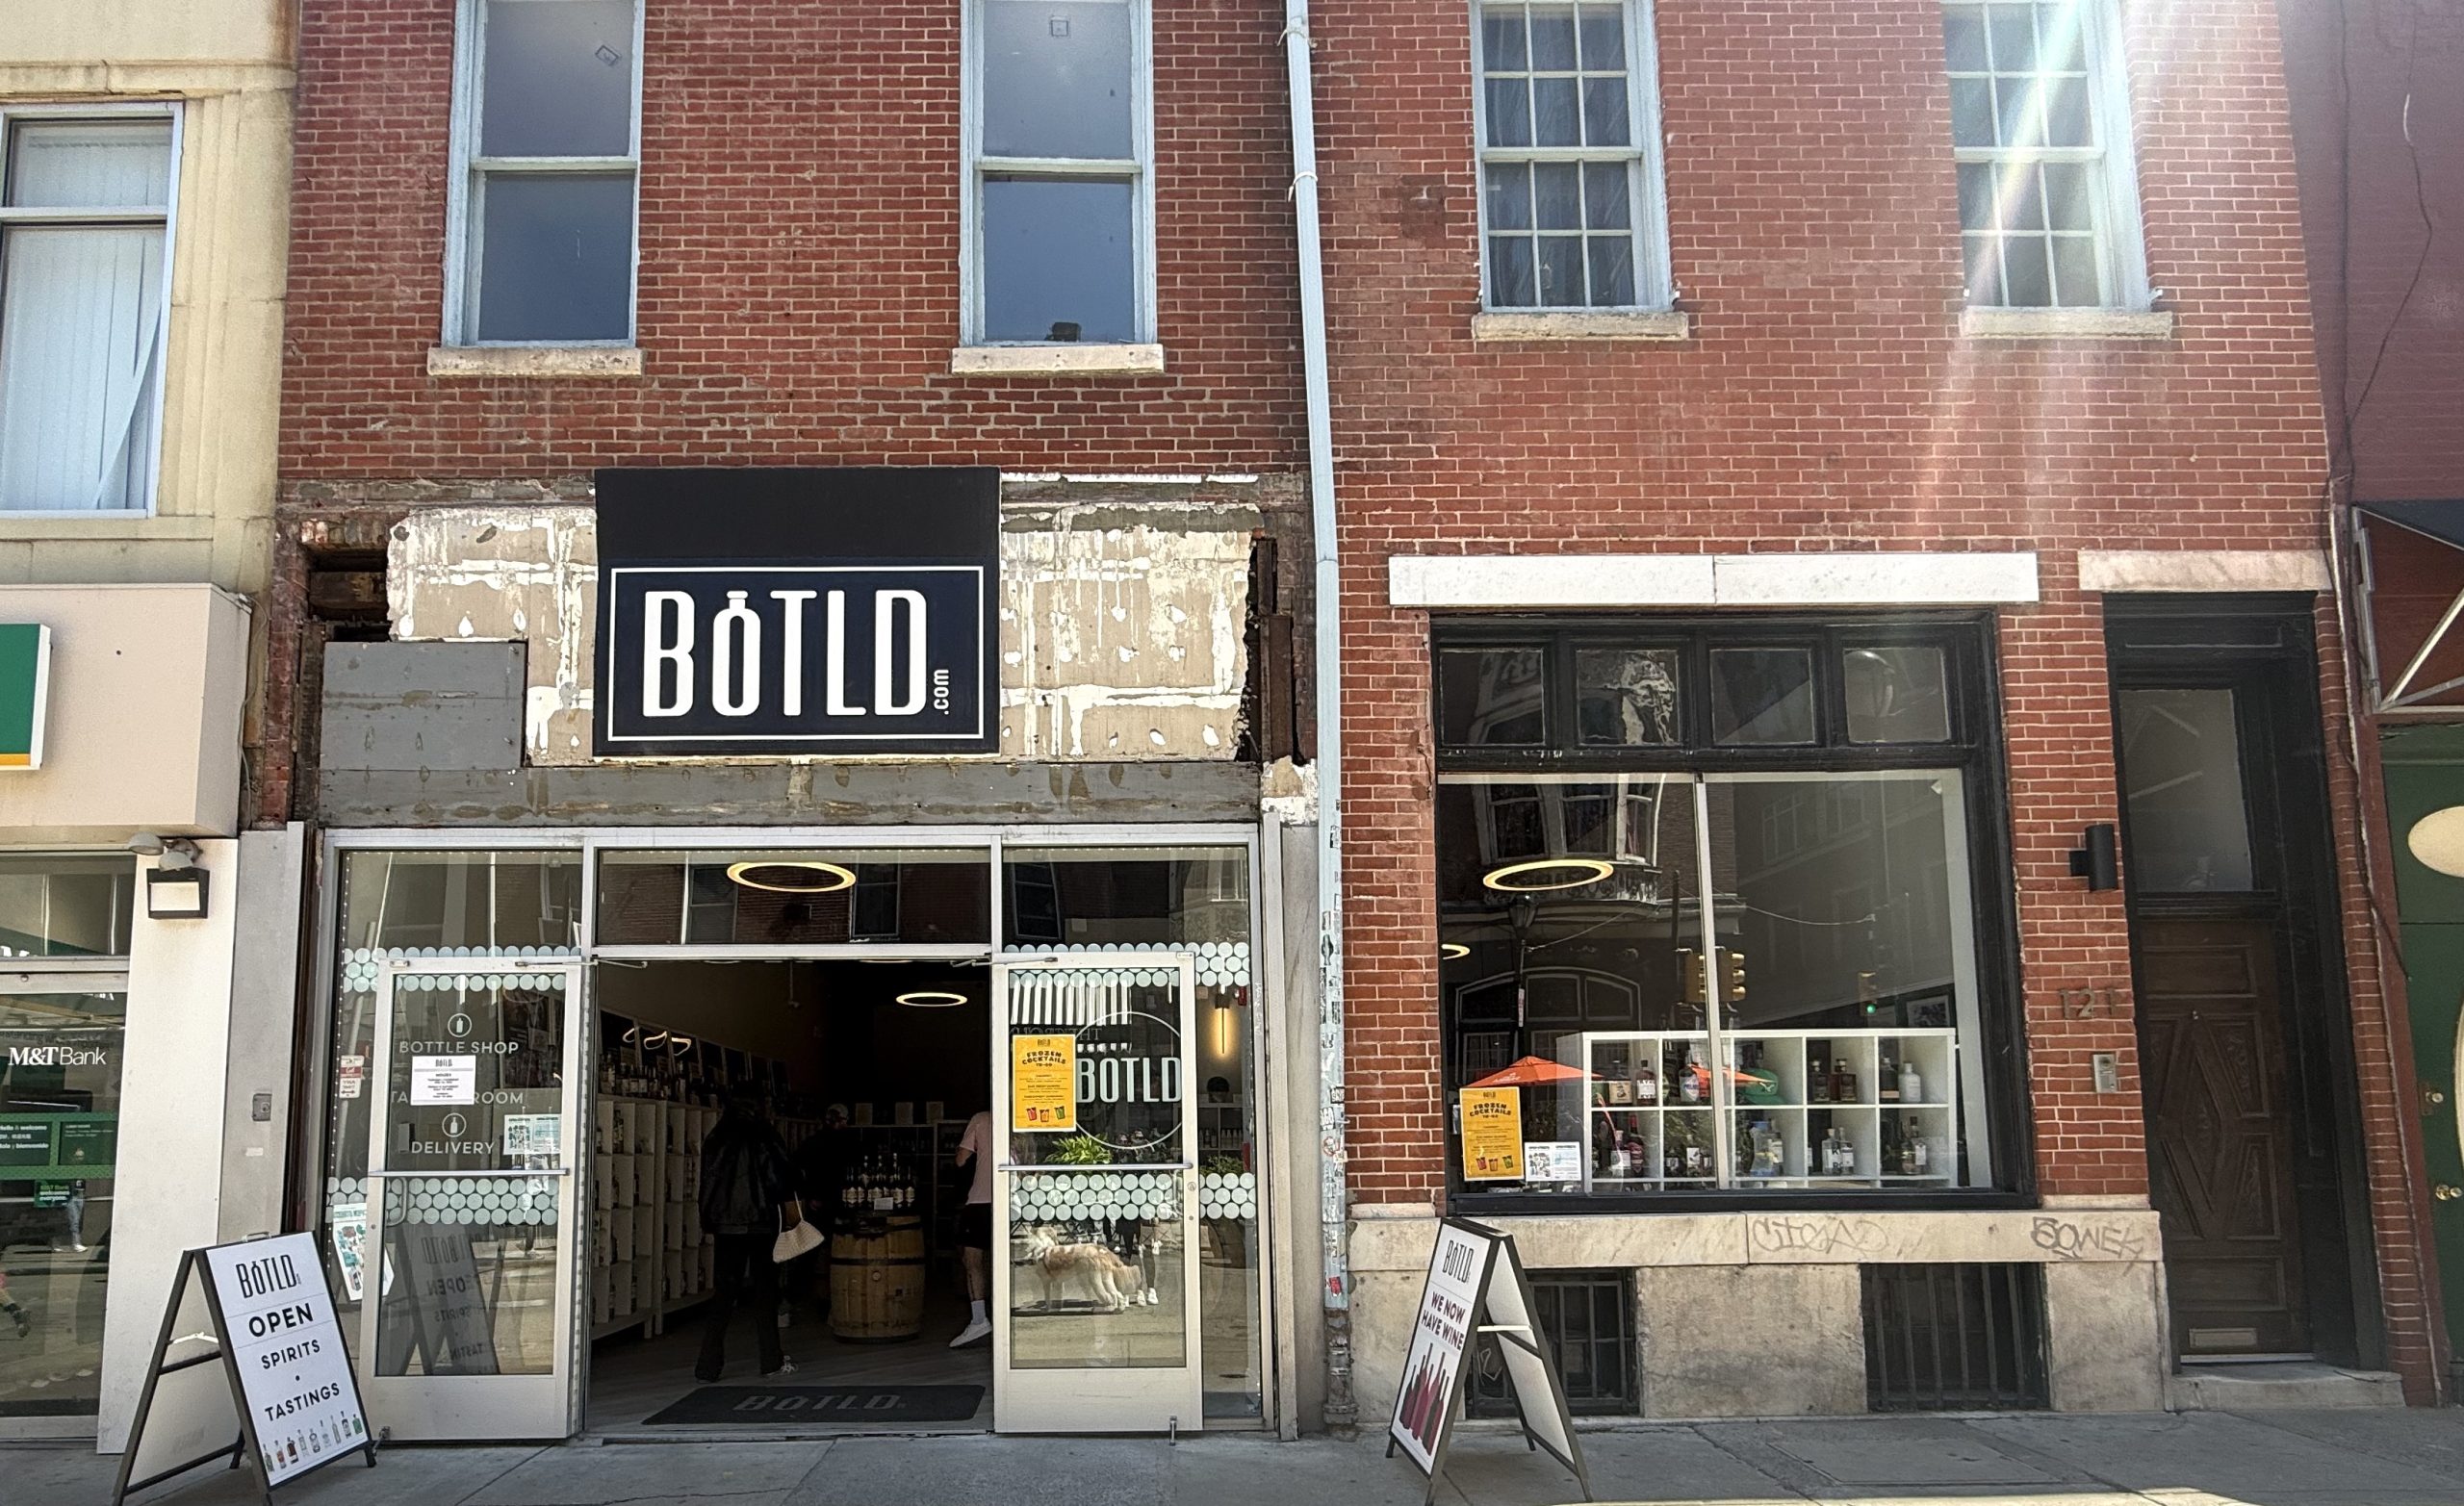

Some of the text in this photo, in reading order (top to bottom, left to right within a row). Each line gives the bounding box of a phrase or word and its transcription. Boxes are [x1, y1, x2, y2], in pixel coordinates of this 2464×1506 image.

[643, 589, 927, 717] BOTLD
[934, 669, 950, 715] .com
[2059, 987, 2117, 1019] 121
[8, 1047, 107, 1066] M&T Bank
[399, 1041, 519, 1054] BOTTLE SHOP
[1076, 1057, 1182, 1103] BOTLD
[475, 1091, 524, 1104] ROOM
[1470, 1108, 1511, 1116] COCKTAILS
[412, 1141, 495, 1154] DELIVERY
[236, 1254, 296, 1298] BOTLD
[248, 1302, 314, 1338] OPEN
[1430, 1291, 1465, 1324] WE NOW
[1421, 1310, 1464, 1351] HAVE WINE
[261, 1339, 321, 1369] SPIRITS
[265, 1382, 340, 1422] TASTINGS
[732, 1394, 901, 1411] BOTLD
